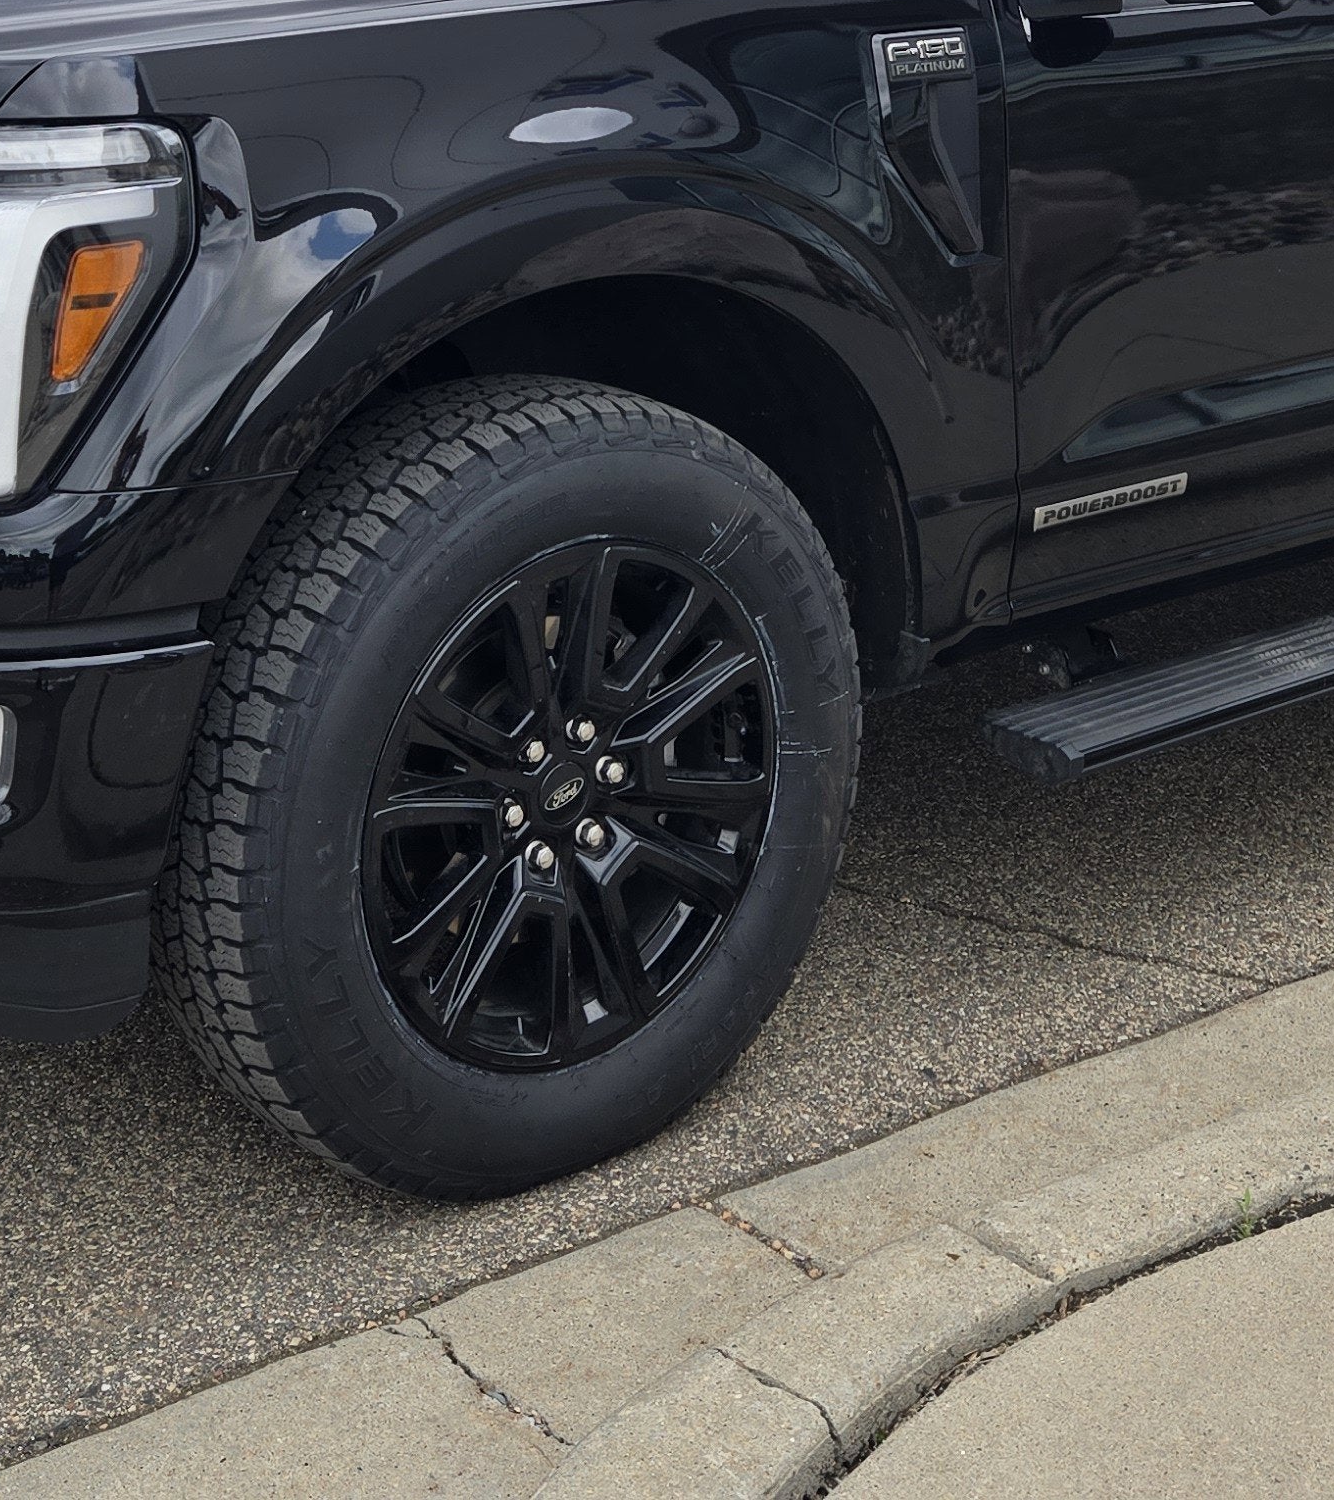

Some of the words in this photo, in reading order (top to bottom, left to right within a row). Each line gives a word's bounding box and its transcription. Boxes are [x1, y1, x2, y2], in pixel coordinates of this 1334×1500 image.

[887, 36, 966, 62] F-150
[896, 58, 965, 76] PLATINUM
[1043, 479, 1182, 525] POWERBOOST
[737, 511, 841, 696] KELLY
[552, 781, 578, 808] Ford
[302, 935, 438, 1135] KELLY
